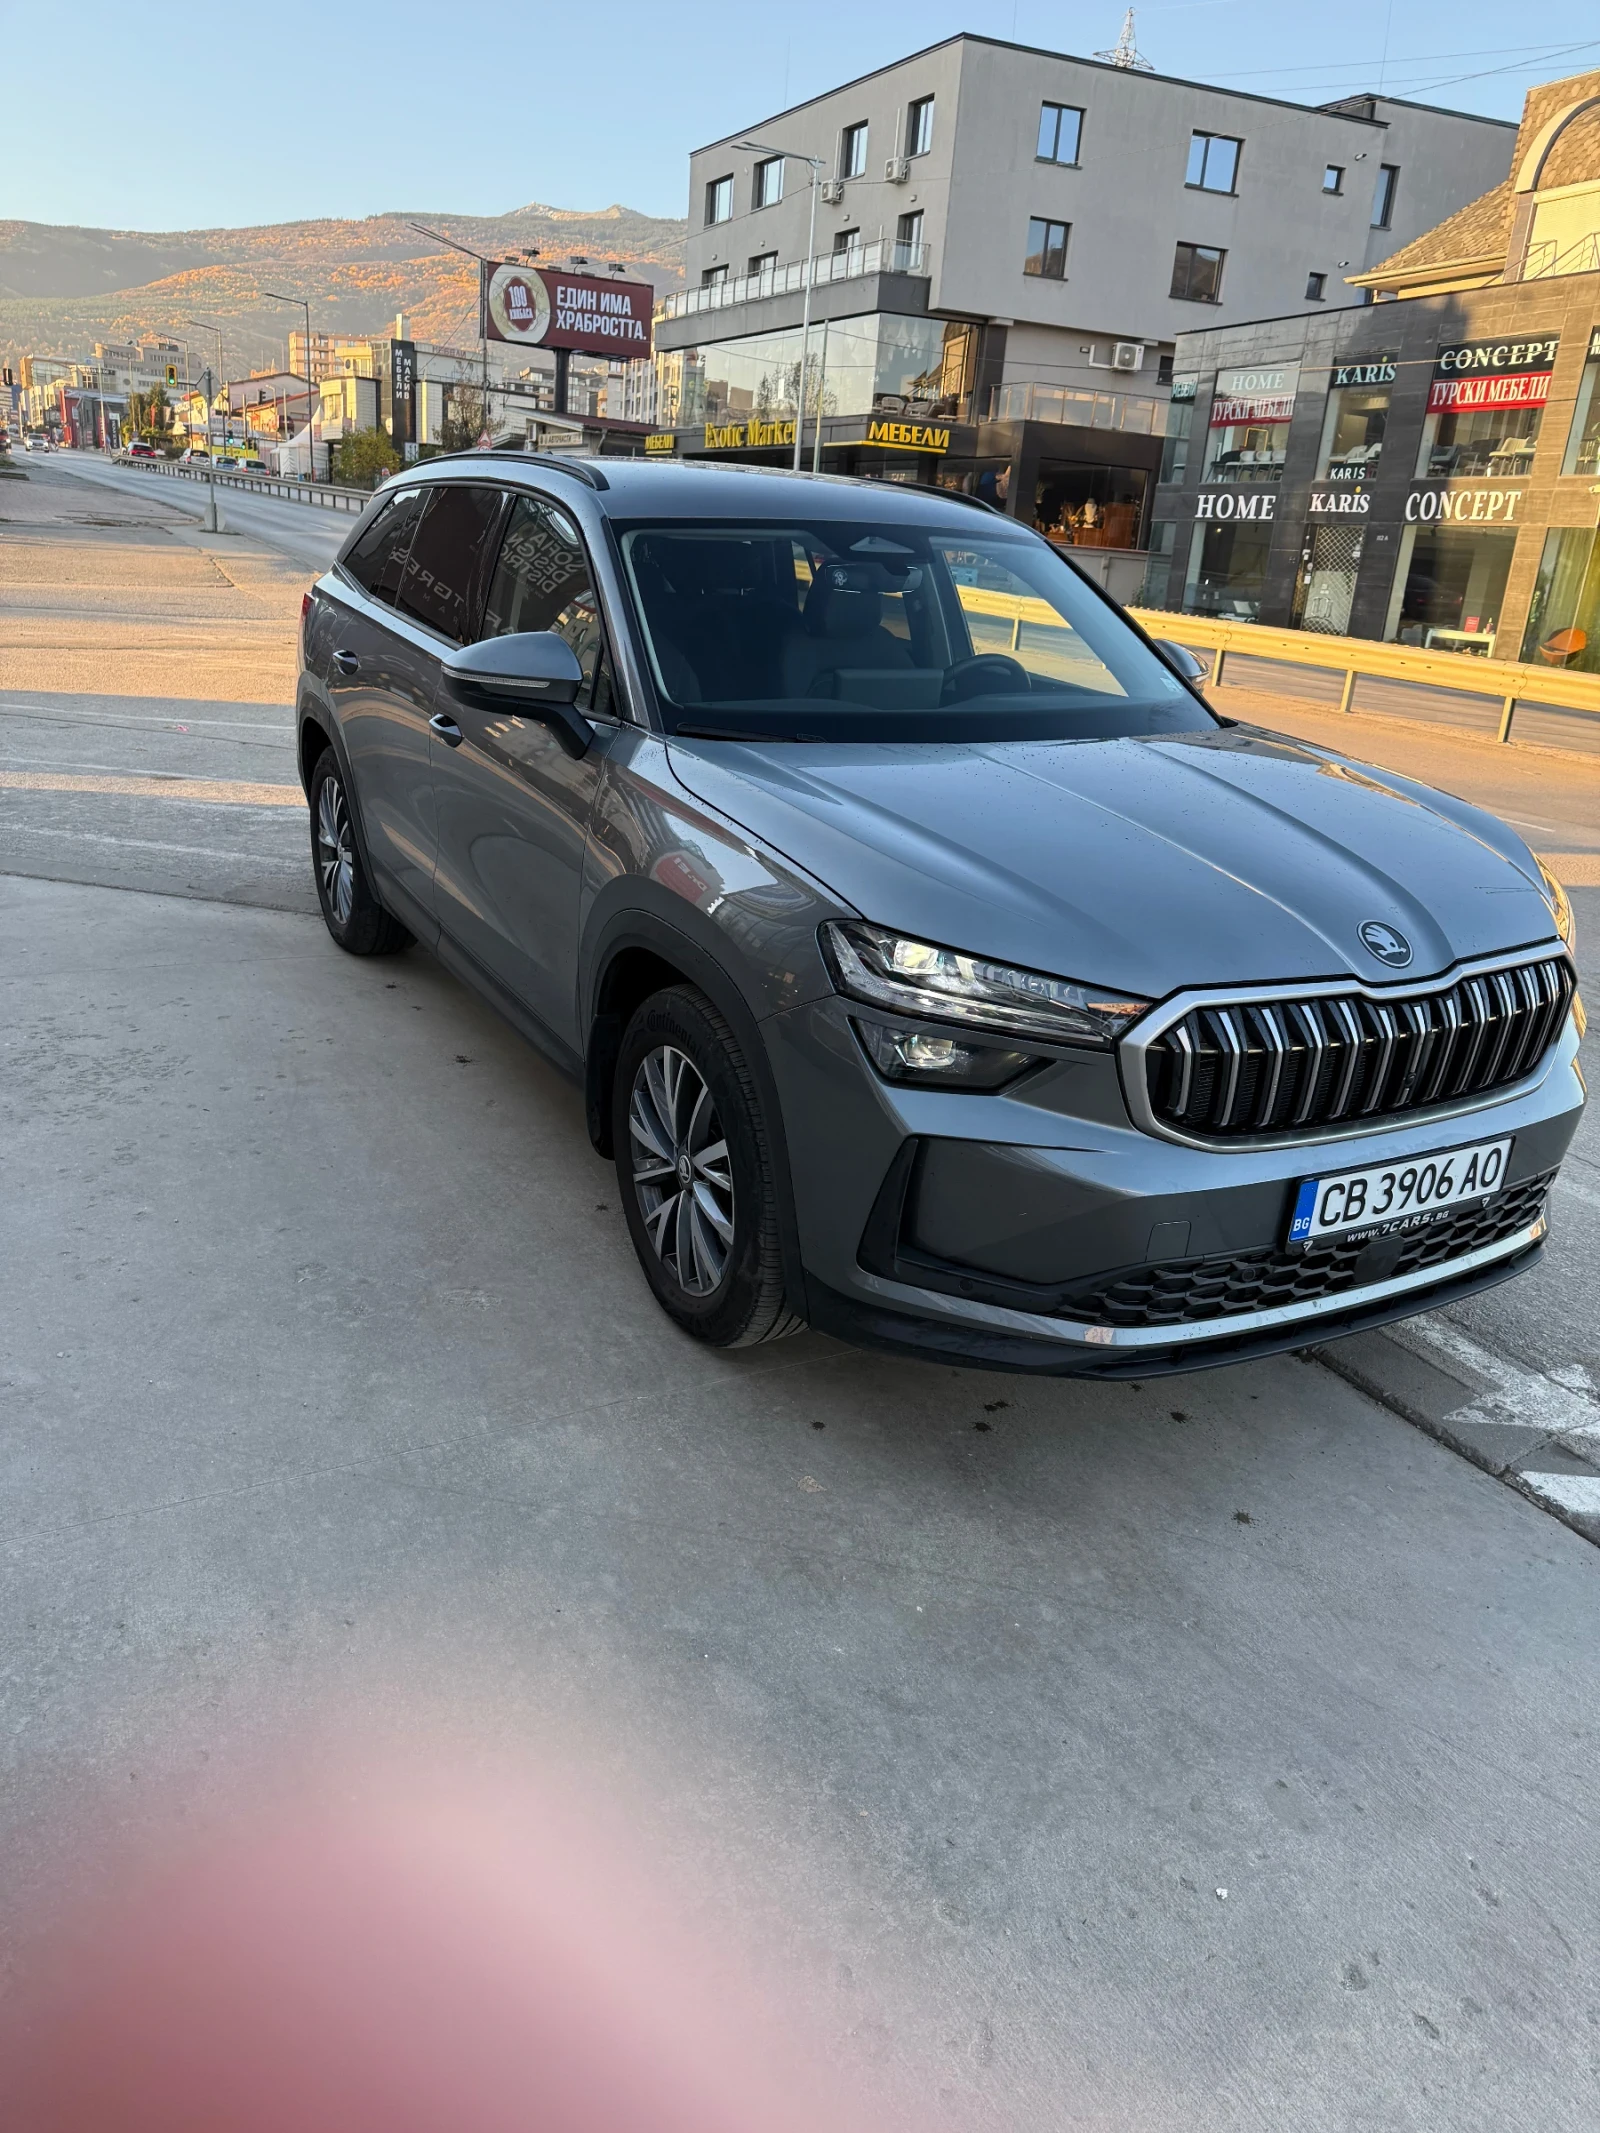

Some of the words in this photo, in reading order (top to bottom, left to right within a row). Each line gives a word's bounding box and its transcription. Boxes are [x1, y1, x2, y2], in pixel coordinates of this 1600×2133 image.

[508, 285, 528, 308] 100
[556, 285, 597, 311] ЕДИН
[600, 291, 632, 316] ИМА
[556, 309, 647, 341] ХРАБРОСТТА.
[1440, 340, 1560, 371] CONCEPT
[395, 349, 403, 399] МЕБЕЛИ
[403, 358, 412, 400] МАСИВ
[1230, 372, 1285, 391] HOME
[1432, 380, 1486, 406] ТУРСКИ
[1488, 375, 1552, 404] МЕБЕЛИ
[1212, 399, 1250, 422] ТУРСКИ
[1252, 395, 1295, 419] МЕБЕЛИ
[645, 434, 675, 450] МЕБЕЛИ
[705, 422, 745, 449] Exotic
[747, 418, 798, 447] Market
[868, 421, 949, 448] МЕБЕЛИ
[1330, 467, 1366, 481] KARIS
[1194, 493, 1277, 520] HOME
[1405, 491, 1522, 521] CONCEPT
[1319, 1178, 1368, 1227] CB
[1371, 1158, 1456, 1215] 3906
[1457, 1147, 1502, 1195] AO
[1293, 1217, 1310, 1232] BG
